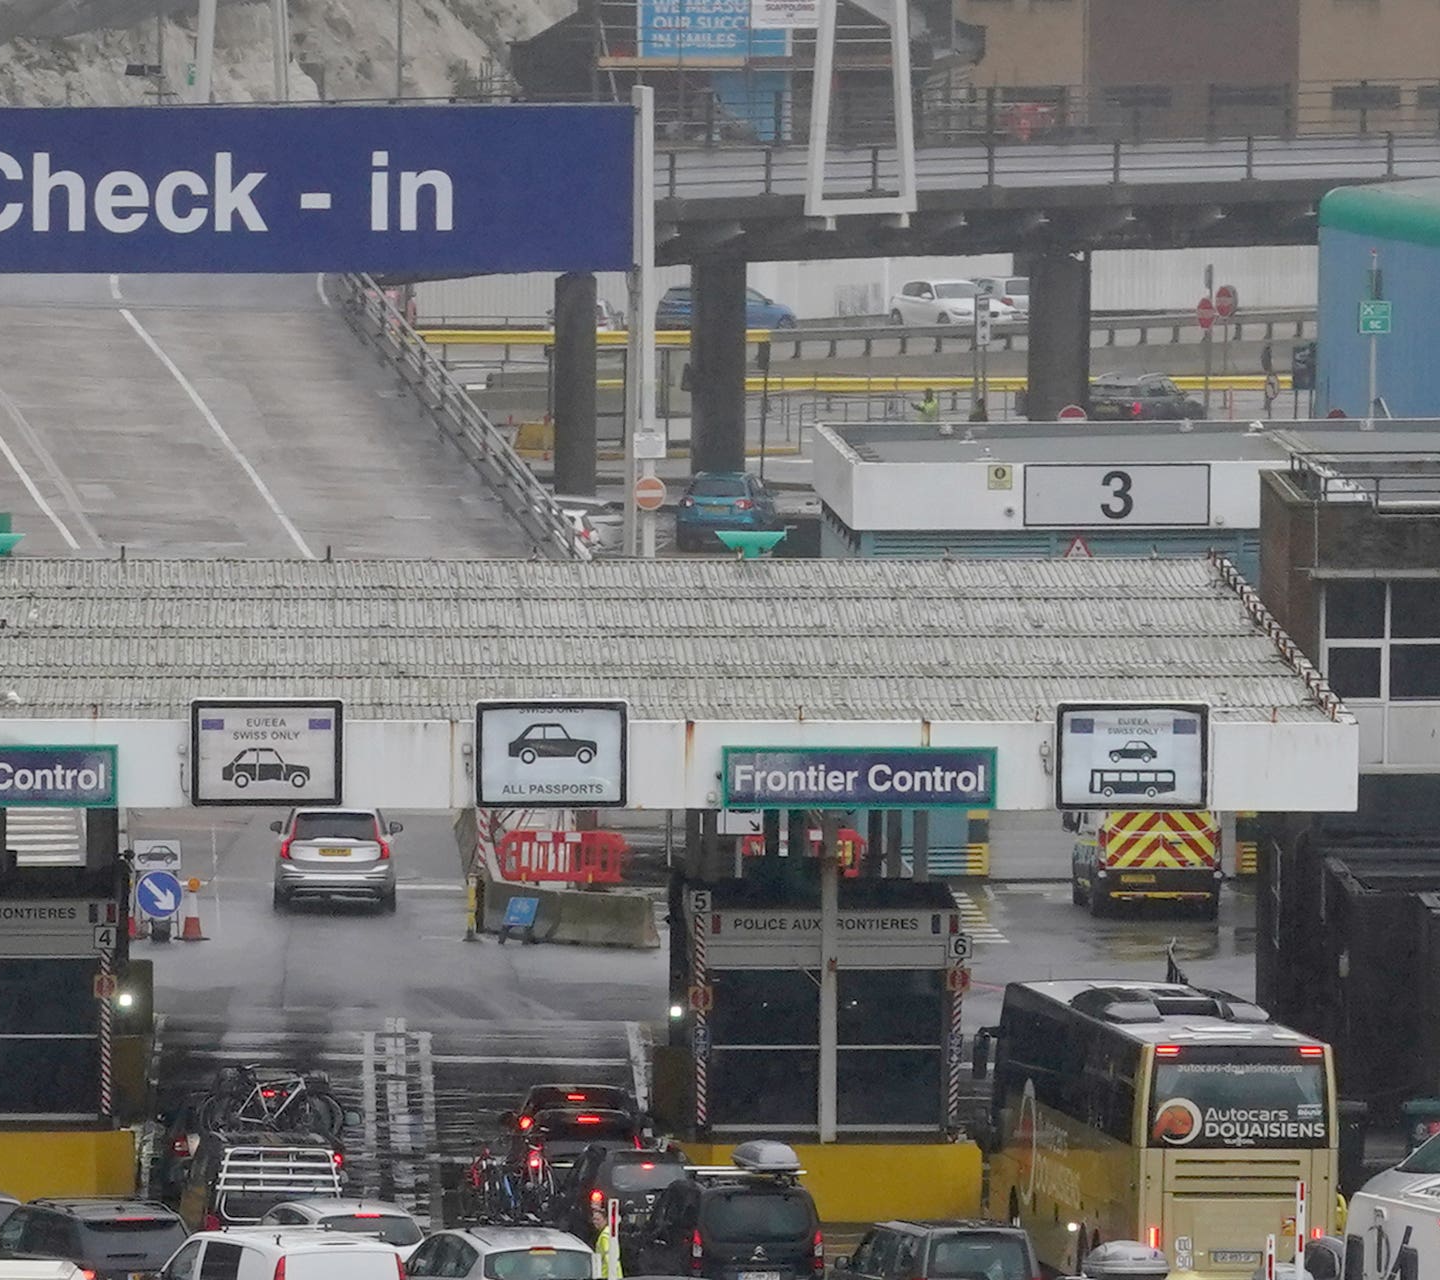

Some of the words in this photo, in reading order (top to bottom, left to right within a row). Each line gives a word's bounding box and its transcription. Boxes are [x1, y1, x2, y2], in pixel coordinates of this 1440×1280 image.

[370, 151, 455, 232] in
[1100, 470, 1134, 519] 3
[246, 718, 287, 727] EU/EEA
[233, 731, 268, 740] SWISS
[270, 731, 299, 740] ONLY
[734, 763, 860, 795] Frontier
[868, 764, 986, 795] Control
[502, 784, 527, 794] ALL
[529, 783, 604, 794] PASSPORTS
[695, 894, 706, 910] 5
[99, 930, 111, 945] 4
[954, 939, 966, 955] 6
[1205, 1108, 1288, 1121] Autocars
[1205, 1123, 1325, 1138] DOUAISIENS
